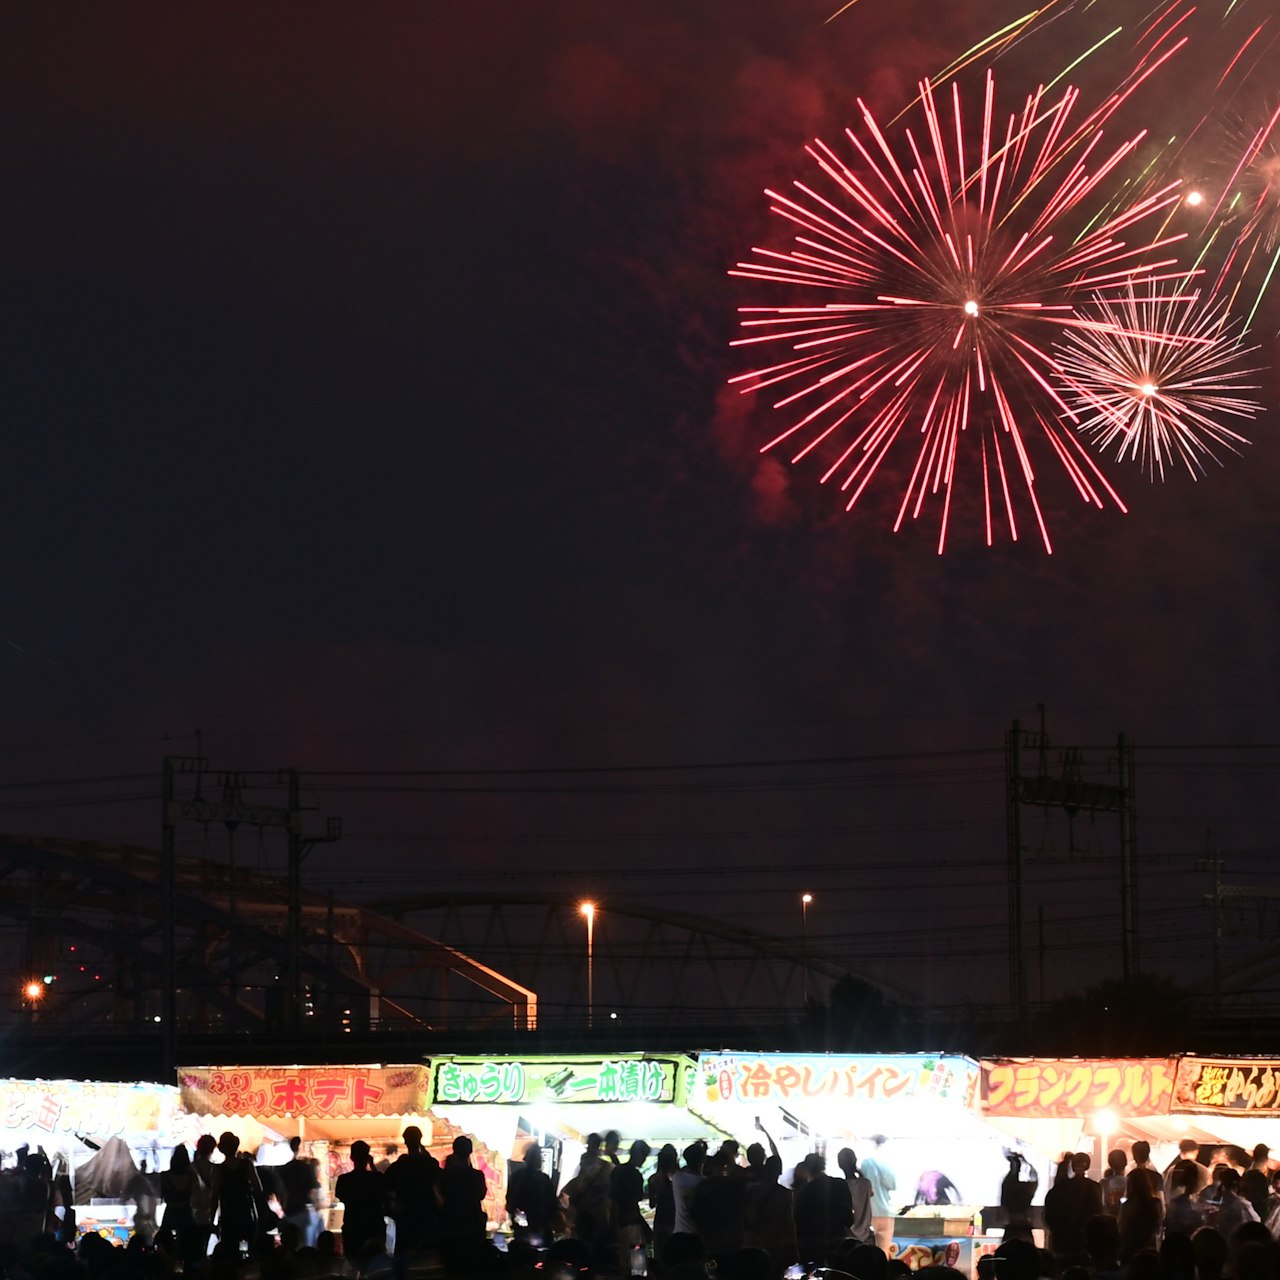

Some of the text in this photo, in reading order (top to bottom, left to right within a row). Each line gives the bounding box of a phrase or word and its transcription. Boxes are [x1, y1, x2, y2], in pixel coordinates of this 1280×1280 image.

[272, 1077, 383, 1112] ポテト
[442, 1063, 525, 1101] きゅうり
[570, 1062, 666, 1101] 一本漬け
[740, 1063, 911, 1099] 冷やしパイン
[988, 1064, 1173, 1108] フランクフルト
